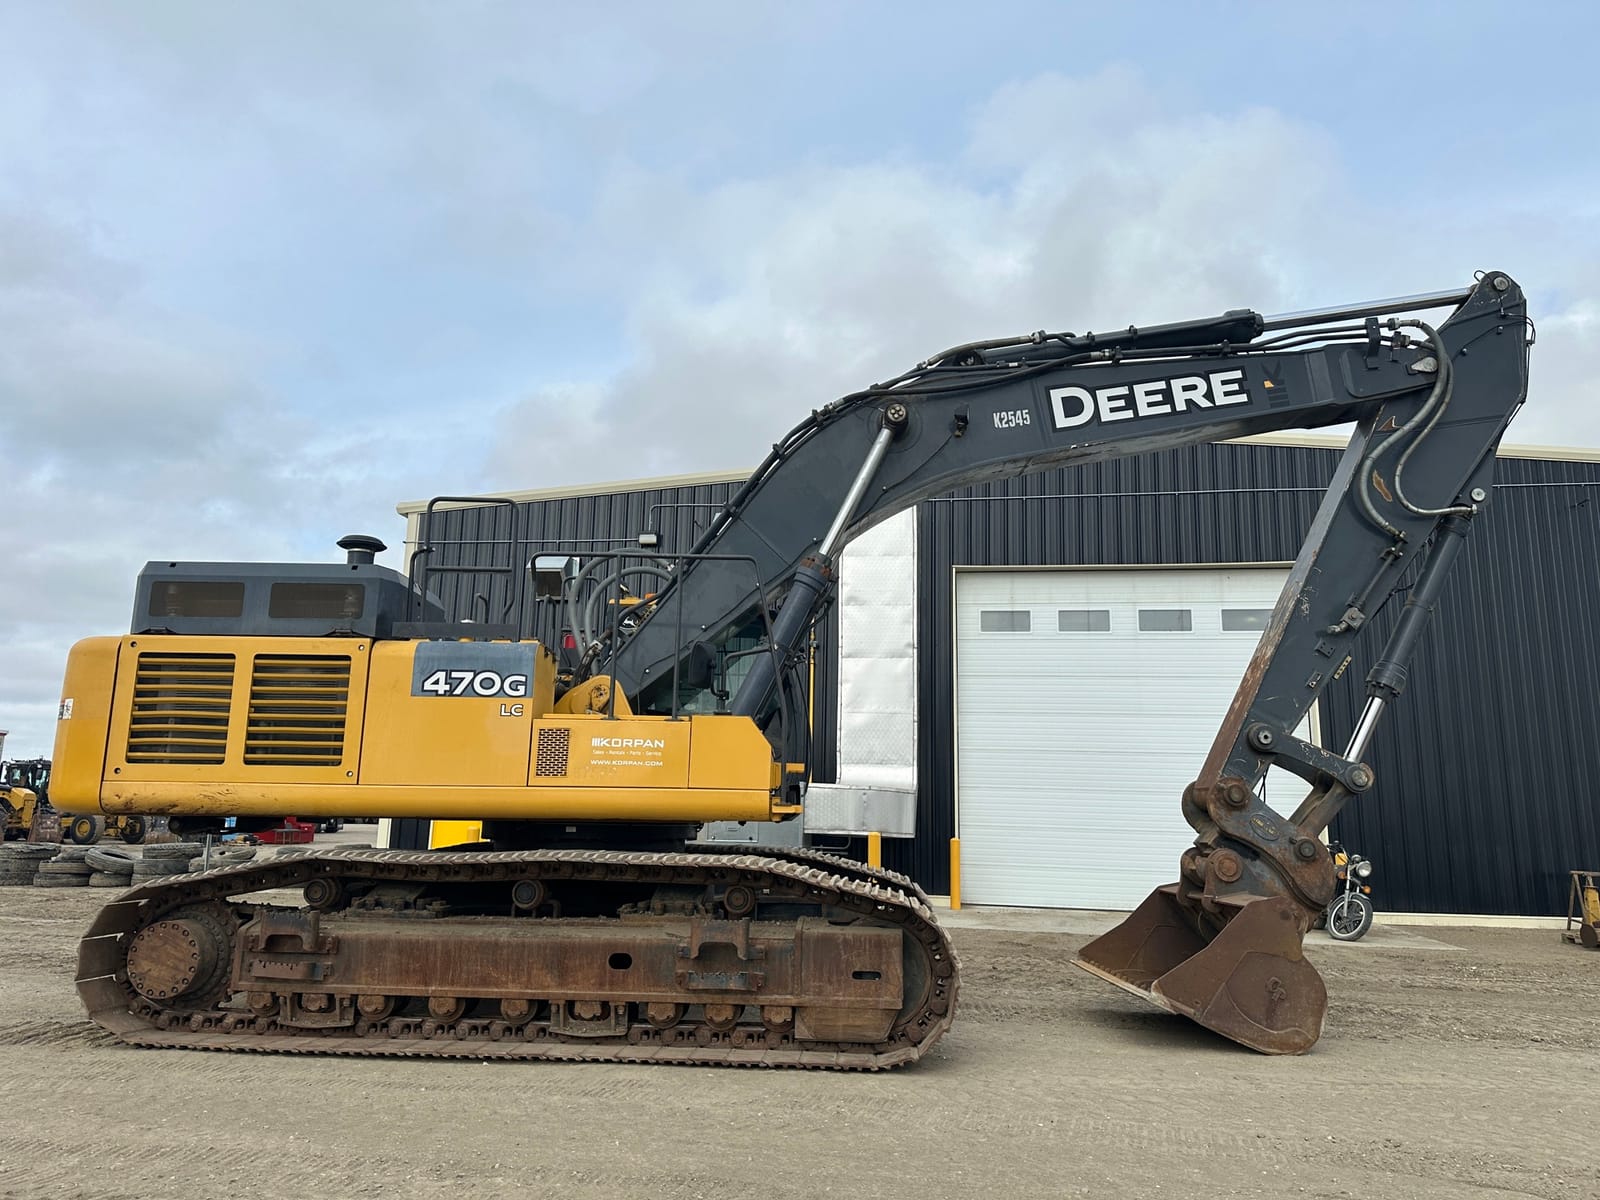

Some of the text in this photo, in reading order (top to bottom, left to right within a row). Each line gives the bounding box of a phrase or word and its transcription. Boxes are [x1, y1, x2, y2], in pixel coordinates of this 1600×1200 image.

[1049, 369, 1249, 429] DEERE
[992, 409, 1031, 429] K2545
[422, 670, 528, 697] 470G
[500, 704, 524, 717] LC
[599, 738, 665, 749] KORPAN
